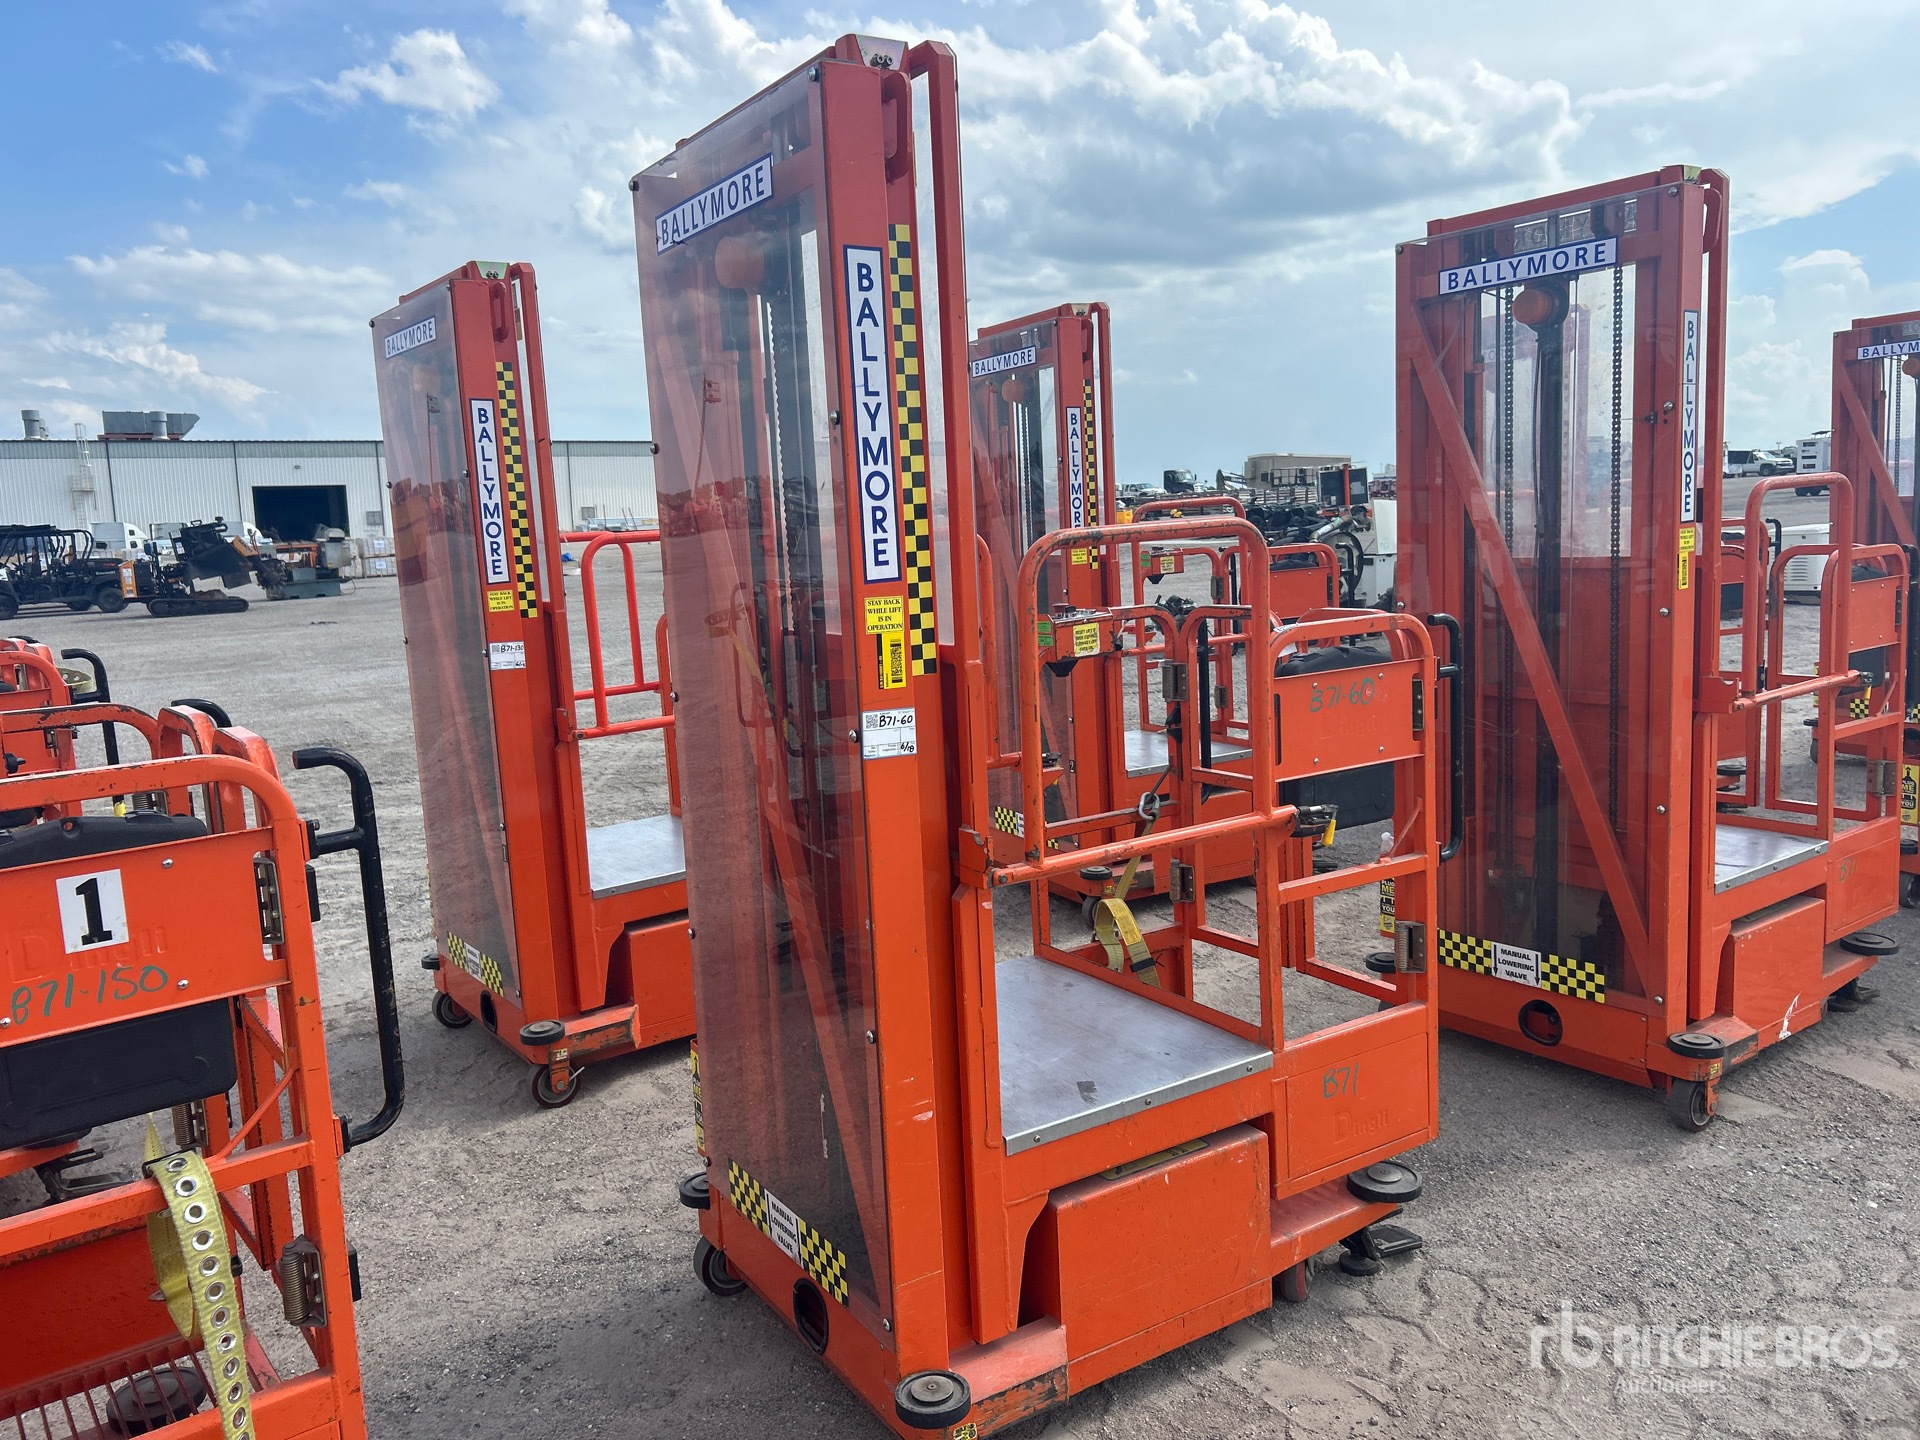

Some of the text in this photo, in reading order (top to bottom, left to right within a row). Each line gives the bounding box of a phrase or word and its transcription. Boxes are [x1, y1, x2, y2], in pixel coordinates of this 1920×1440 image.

[660, 164, 765, 247] BALLYMORE
[1447, 242, 1607, 291] BALLYMORE
[386, 321, 434, 356] BALLYMORE
[974, 350, 1033, 375] BALLYMORE
[856, 262, 891, 567] BALLYMORE
[1683, 320, 1695, 513] BALLYMORE
[1070, 413, 1083, 529] BALLYMOR
[477, 407, 503, 577] BALLYMORE
[867, 622, 903, 632] OPERATION
[1309, 677, 1375, 713] B71-60
[879, 714, 914, 728] B71-60
[1381, 884, 1395, 894] ME
[75, 877, 114, 946] 1
[1381, 904, 1395, 913] YOU
[1497, 957, 1535, 972] LOWERING
[1500, 948, 1532, 962] MANUAL
[1505, 969, 1528, 981] VALVE
[1323, 1061, 1359, 1099] B71
[1333, 1109, 1389, 1146] Dingli
[770, 1216, 797, 1243] LOWERING
[771, 1201, 794, 1227] MANUAL
[776, 1232, 794, 1254] VALVE
